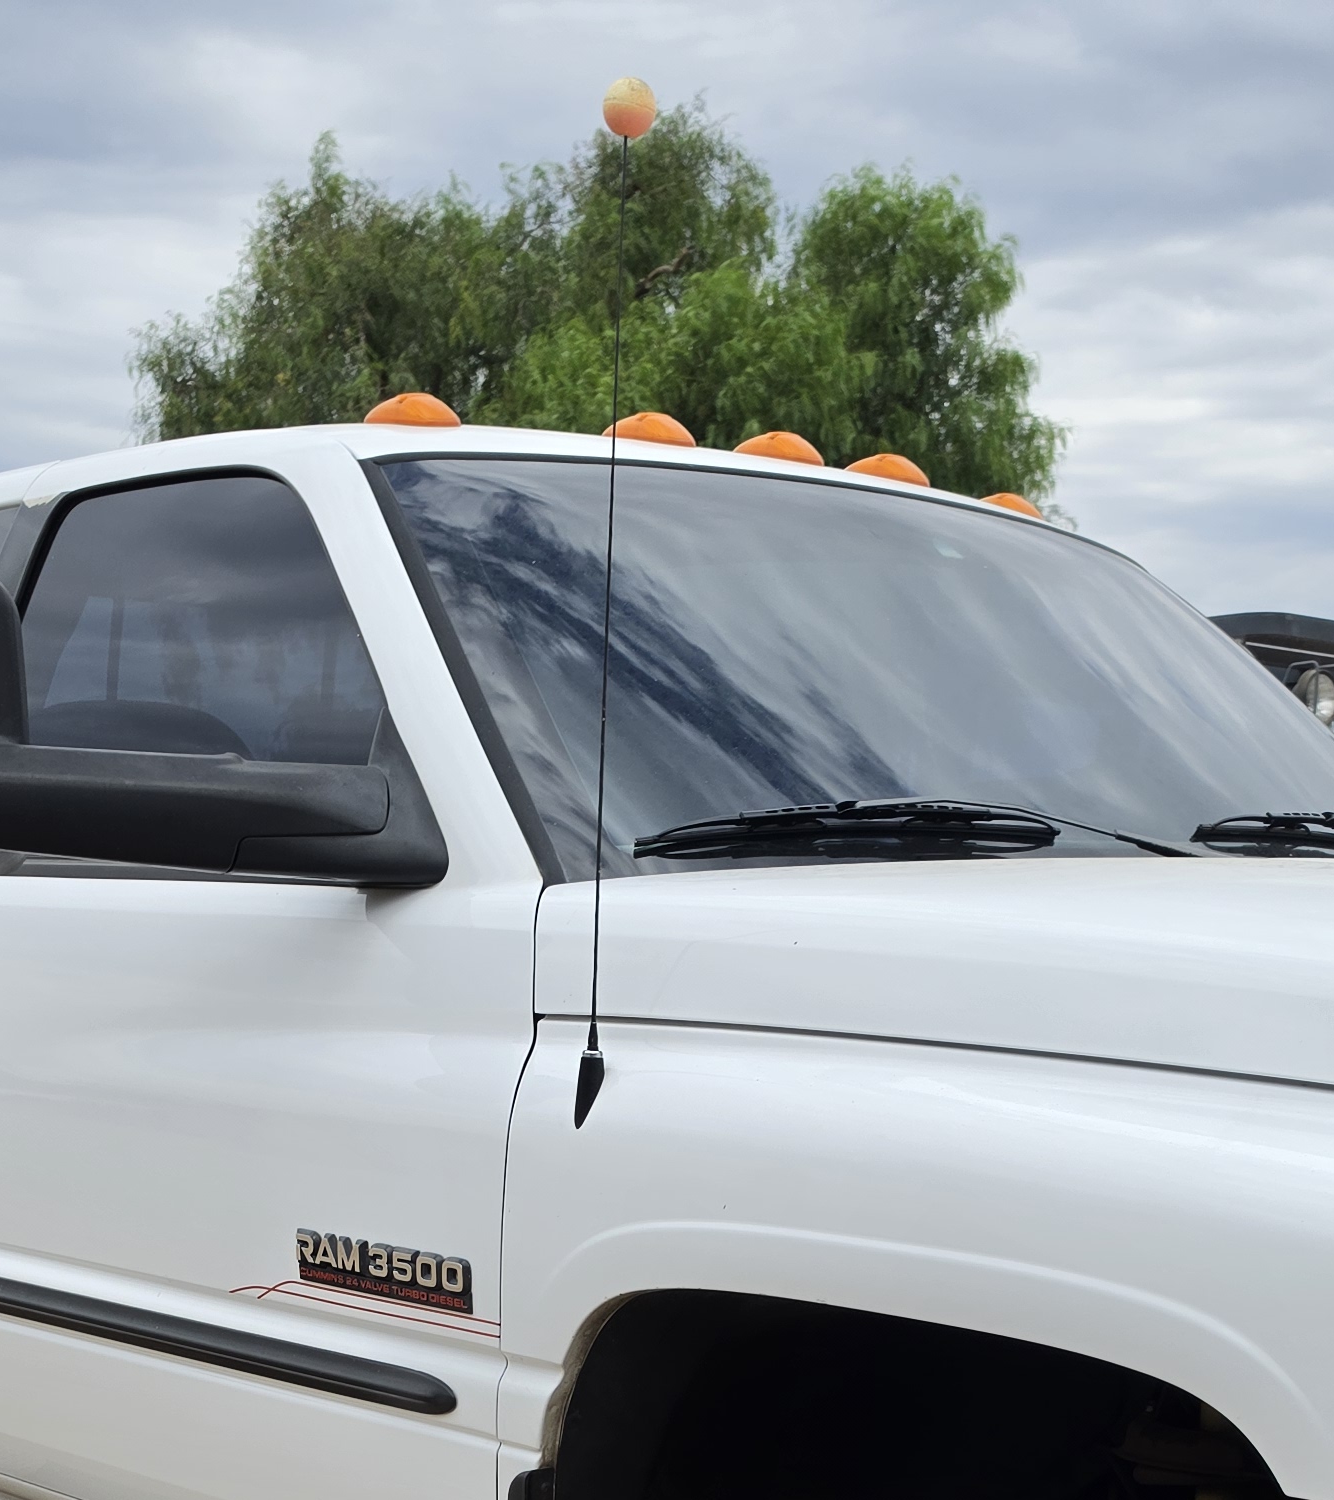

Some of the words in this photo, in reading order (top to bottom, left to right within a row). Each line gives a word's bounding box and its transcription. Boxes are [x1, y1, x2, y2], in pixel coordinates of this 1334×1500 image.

[296, 1230, 365, 1273] RAM
[368, 1244, 467, 1293] 3500
[300, 1267, 344, 1284] CUMMINS
[346, 1275, 359, 1286] 24
[360, 1279, 390, 1293] VALVE
[392, 1285, 427, 1300] TURBO
[428, 1294, 468, 1308] DIESEL
